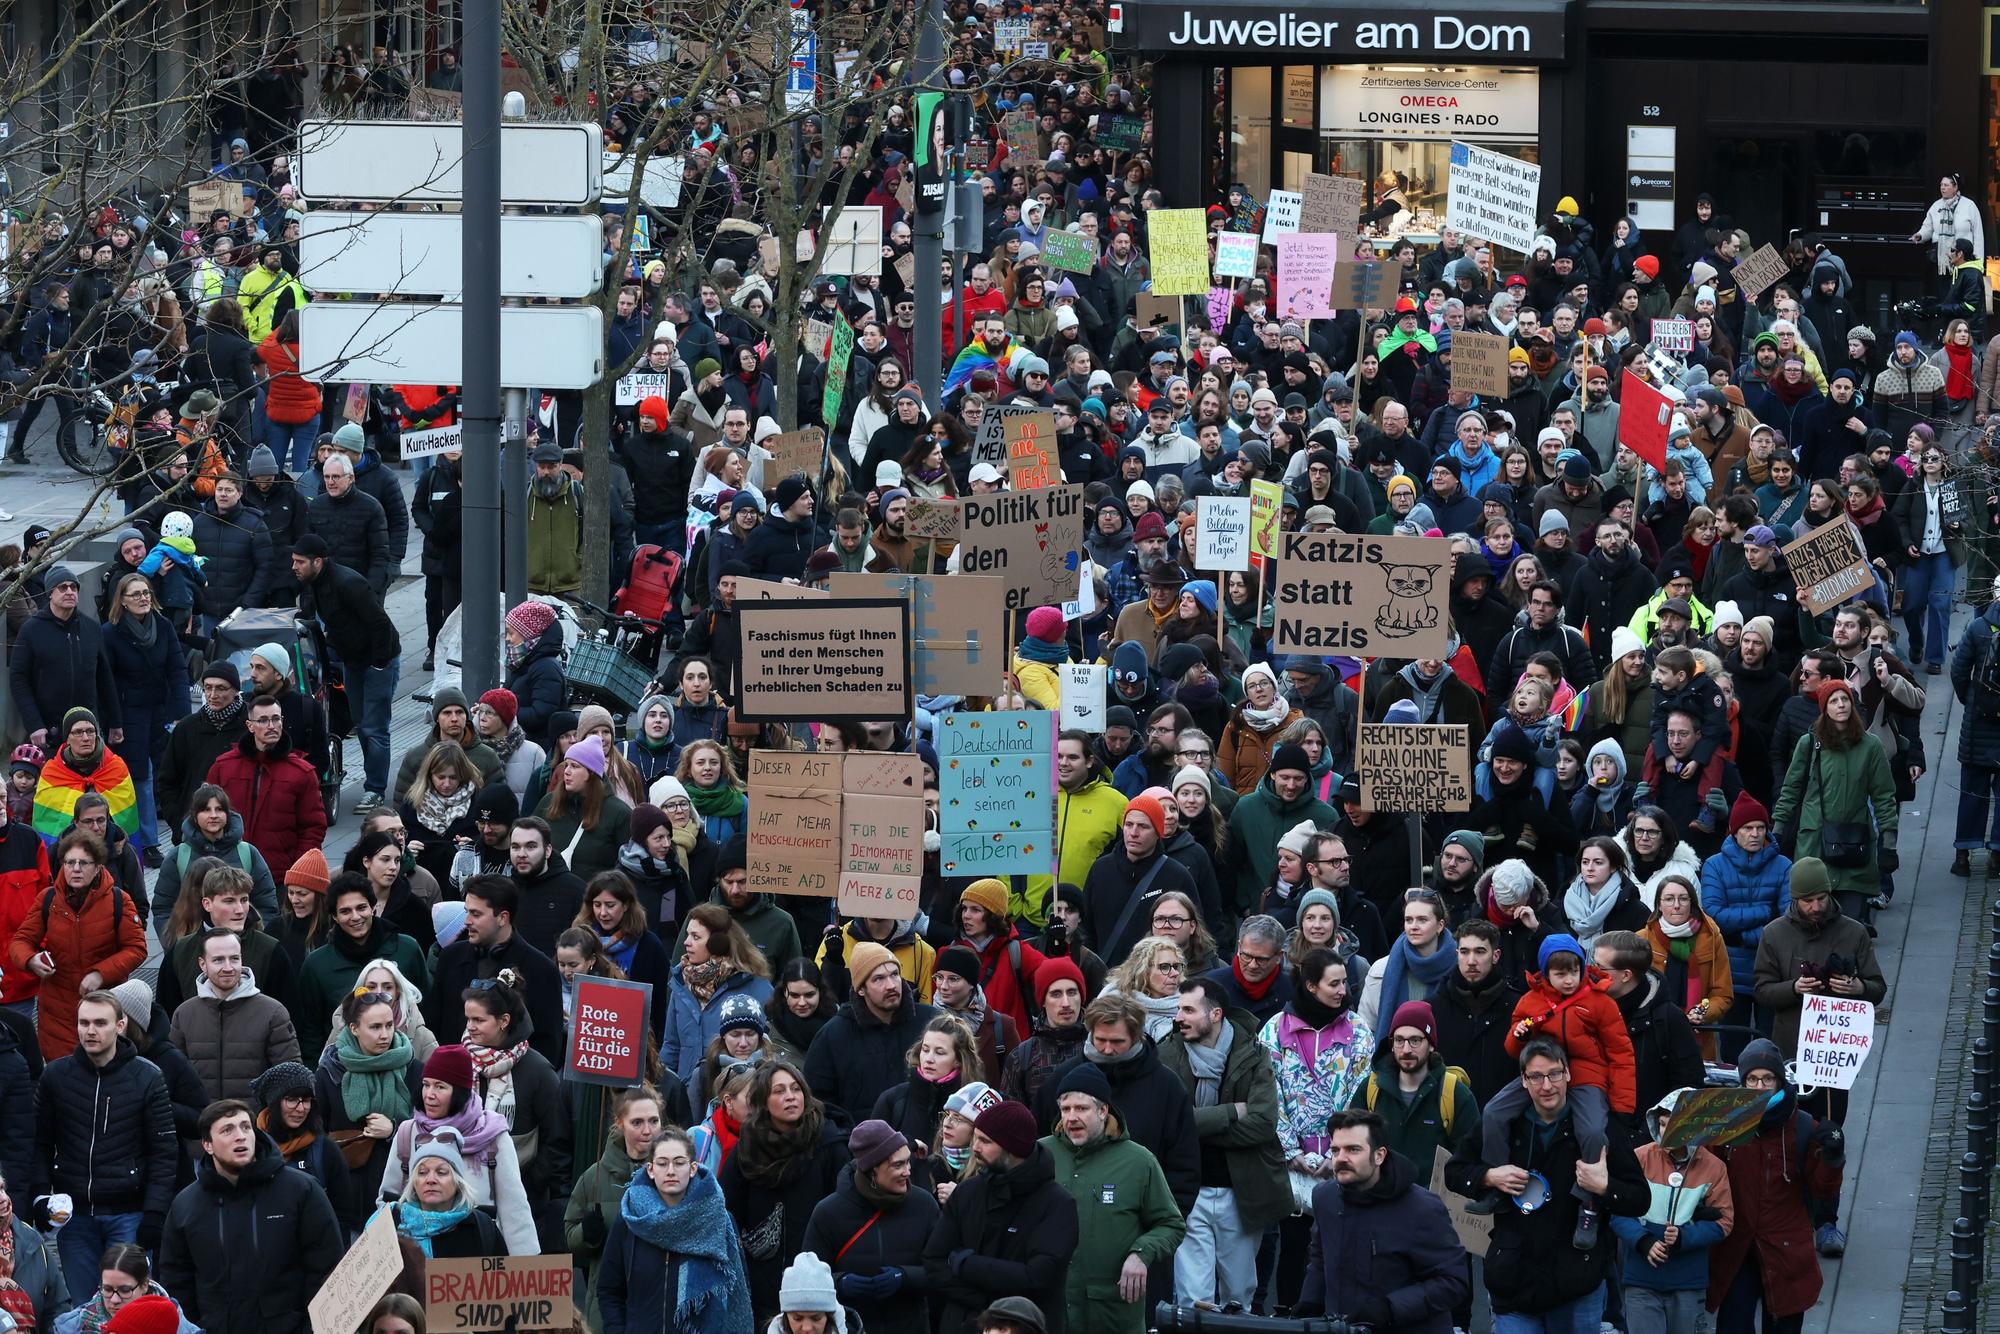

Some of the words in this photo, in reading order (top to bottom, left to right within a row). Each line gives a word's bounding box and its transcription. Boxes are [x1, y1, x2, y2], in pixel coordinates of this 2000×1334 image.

[1169, 11, 1338, 48] Juwelier
[1355, 23, 1419, 49] am
[1434, 16, 1531, 52] Dom
[1290, 79, 1312, 88] Juwelier
[1361, 77, 1421, 87] Zertifiziertes
[1424, 78, 1498, 89] Service-Center
[1300, 89, 1312, 98] Dom
[1400, 96, 1458, 107] OMEGA
[1643, 105, 1660, 116] 52
[1359, 112, 1440, 124] LONGINES
[1454, 115, 1499, 126] RADO
[1306, 177, 1339, 190] FRITZE
[1343, 181, 1361, 194] MERZ
[1456, 184, 1469, 196] und
[1485, 172, 1499, 188] Bett
[1501, 180, 1530, 198] scheißen
[1305, 189, 1335, 201] FISCHT
[1304, 201, 1350, 217] FASCHOS
[1456, 201, 1463, 210] in
[1465, 202, 1476, 215] der
[1480, 205, 1505, 224] braunen
[1508, 214, 1529, 232] Kacke
[1157, 222, 1172, 233] FÜR
[1176, 222, 1198, 232] ALLE
[1456, 218, 1490, 236] schlafen
[1490, 229, 1501, 238] zu
[1503, 232, 1530, 249] müssen
[1048, 234, 1063, 245] CDU
[1082, 240, 1093, 251] NIE
[1177, 233, 1200, 244] NICHT
[1221, 247, 1253, 262] DEMO
[1284, 242, 1303, 252] Jetzt
[1180, 254, 1198, 264] DICH
[1217, 261, 1252, 273] CRACY
[1732, 262, 1756, 284] KEINE
[1752, 246, 1777, 270] MACHT
[1152, 266, 1167, 276] DAS
[1170, 265, 1182, 275] IST
[1185, 265, 1206, 275] KEIN
[1743, 277, 1763, 294] DEN
[1758, 258, 1789, 286] FASCHOS
[1654, 336, 1692, 348] BUNT
[1466, 349, 1486, 360] NERVEN
[1471, 363, 1482, 375] HAT
[1482, 366, 1495, 377] NUR
[619, 375, 633, 385] NIE
[636, 375, 665, 385] WIEDER
[621, 387, 631, 396] IST
[634, 386, 663, 398] JETZT
[800, 432, 820, 442] NETZ
[1020, 423, 1039, 439] no
[1011, 439, 1034, 456] one
[964, 495, 1040, 529] Politik
[1046, 490, 1081, 518] für
[1209, 503, 1239, 517] Mehr
[1252, 494, 1272, 510] BUNT
[1206, 517, 1245, 534] Bildung
[1218, 534, 1235, 546] für
[1786, 543, 1816, 570] NAZIS
[1815, 522, 1853, 555] HASSEN
[1208, 541, 1238, 559] Nazis!
[1284, 534, 1383, 564] Katzis
[963, 546, 1008, 573] den
[1796, 556, 1831, 589] DIESEN
[1826, 542, 1860, 574] TRICK
[1279, 579, 1353, 605] statt
[1815, 568, 1862, 605] BILDUNG
[748, 630, 825, 641] Faschismus
[829, 630, 856, 643] fügt
[860, 629, 896, 640] Ihnen
[1278, 618, 1368, 649] Nazis
[761, 648, 785, 658] und
[789, 648, 813, 658] den
[817, 647, 884, 658] Menschen
[762, 665, 774, 675] in
[778, 665, 810, 675] Ihrer
[813, 664, 884, 677] Umgebung
[744, 682, 822, 693] erheblichen
[826, 681, 883, 692] Schaden
[887, 682, 902, 692] zu
[1073, 676, 1089, 684] 1933
[1073, 705, 1087, 713] CDU
[951, 727, 1033, 755] Deutschland
[1361, 726, 1415, 746] RECHTS
[1416, 727, 1436, 746] IST
[1437, 728, 1466, 747] WIE
[1361, 748, 1398, 768] WLAN
[1402, 748, 1447, 769] OHNE
[752, 758, 791, 775] DIESER
[801, 760, 830, 777] AST
[995, 774, 1022, 788] von
[974, 796, 1015, 812] seinen
[1374, 800, 1446, 813] UNSICHER
[758, 811, 783, 827] HAT
[797, 815, 831, 831] MEHR
[850, 824, 877, 837] FÜR
[889, 825, 910, 838] DIE
[750, 832, 832, 849] MENSCHLICHKEIT
[951, 835, 1018, 862] Farben
[850, 843, 913, 861] DEMOKRATIE
[751, 861, 770, 873] ALS
[778, 864, 793, 874] DIE
[849, 860, 880, 872] GETAN
[893, 863, 912, 873] ALS
[750, 875, 789, 887] GESAMTE
[798, 874, 825, 889] AfD
[845, 880, 882, 900] MERZ
[885, 888, 893, 899] &
[897, 889, 916, 902] CO.
[581, 1005, 618, 1022] Rote
[1806, 997, 1827, 1011] NIE
[1831, 1001, 1866, 1014] WIEDER
[1817, 1013, 1850, 1027] MUSS
[579, 1021, 625, 1039] Karte
[1805, 1028, 1826, 1043] NIE
[1830, 1032, 1868, 1047] WIEDER
[578, 1037, 603, 1052] für
[605, 1041, 630, 1056] die
[577, 1054, 613, 1071] AfD!
[1804, 1048, 1858, 1067] BLEIBEN
[481, 1257, 506, 1271] DIE
[430, 1268, 573, 1304] BRANDMAUER
[455, 1303, 504, 1328] SIND
[510, 1300, 552, 1325] WIR
